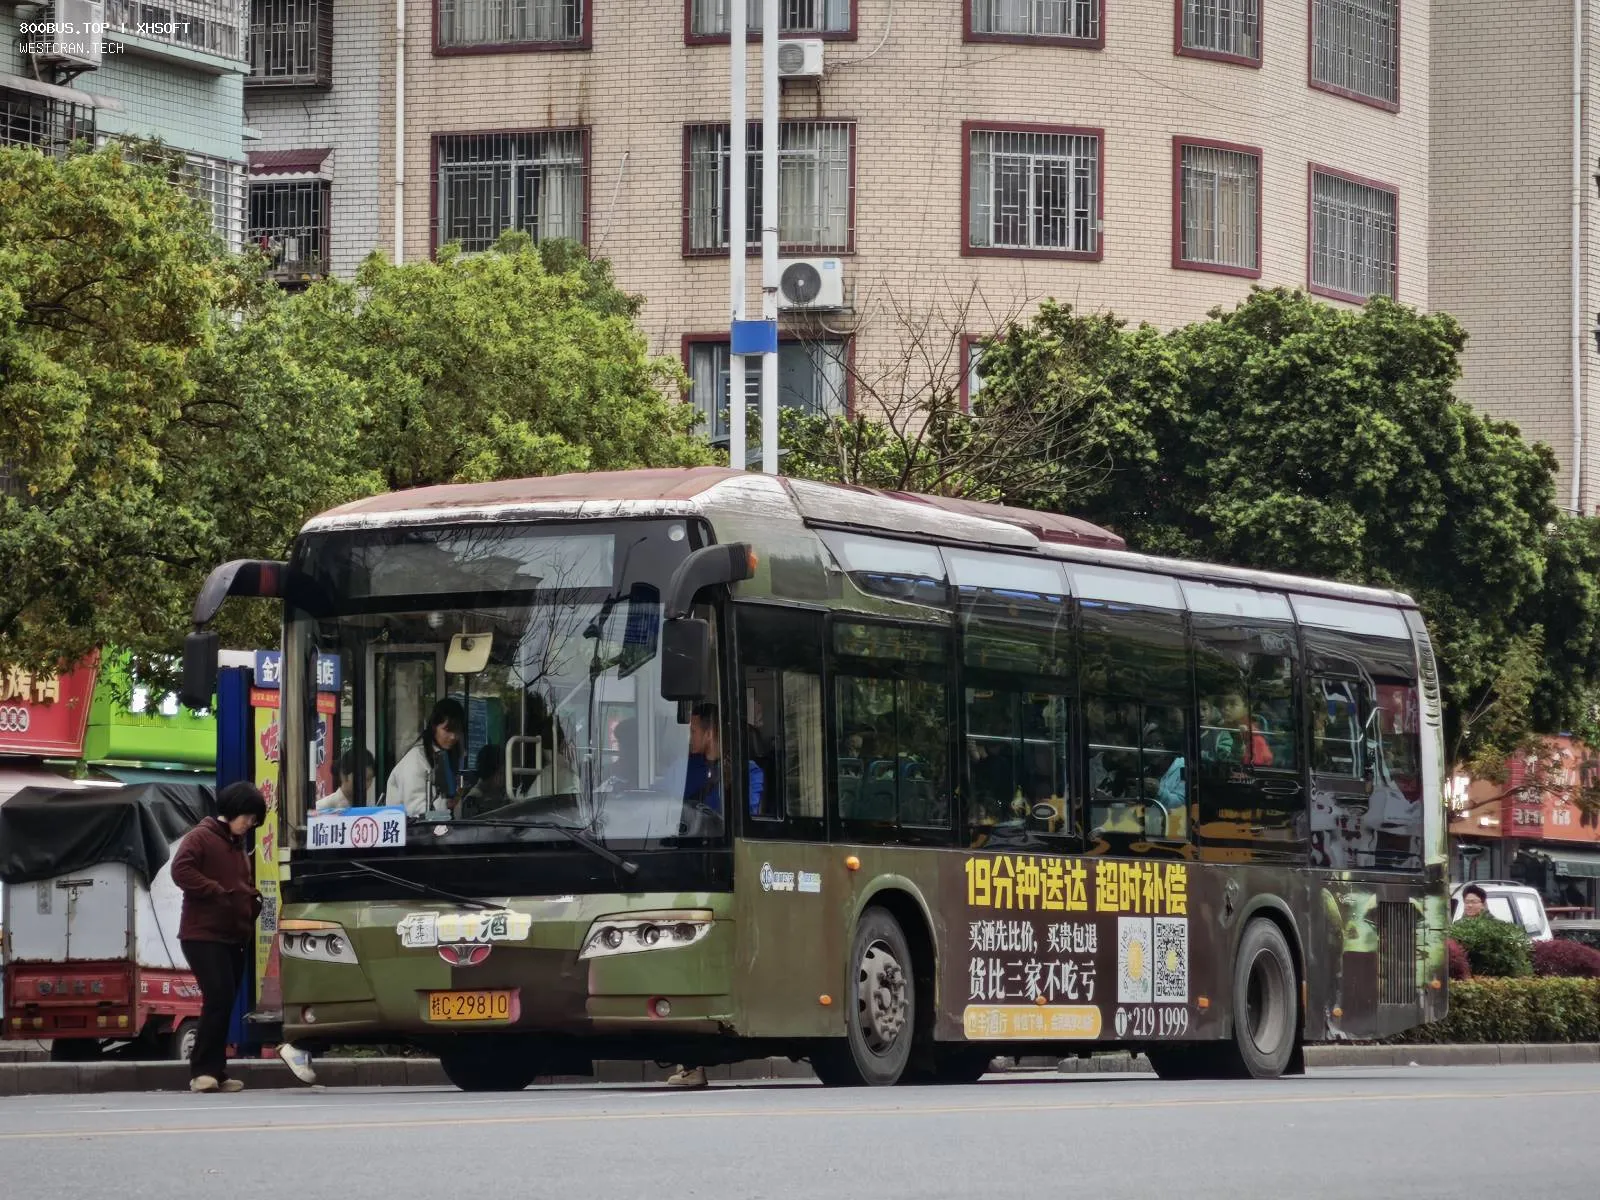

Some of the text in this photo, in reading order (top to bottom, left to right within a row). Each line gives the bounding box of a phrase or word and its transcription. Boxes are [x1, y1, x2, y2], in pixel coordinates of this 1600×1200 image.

[965, 855, 1187, 915] 19分钟送达 超时补偿
[968, 957, 1097, 1002] 货比三家不吃亏
[1158, 1006, 1189, 1036] 1999
